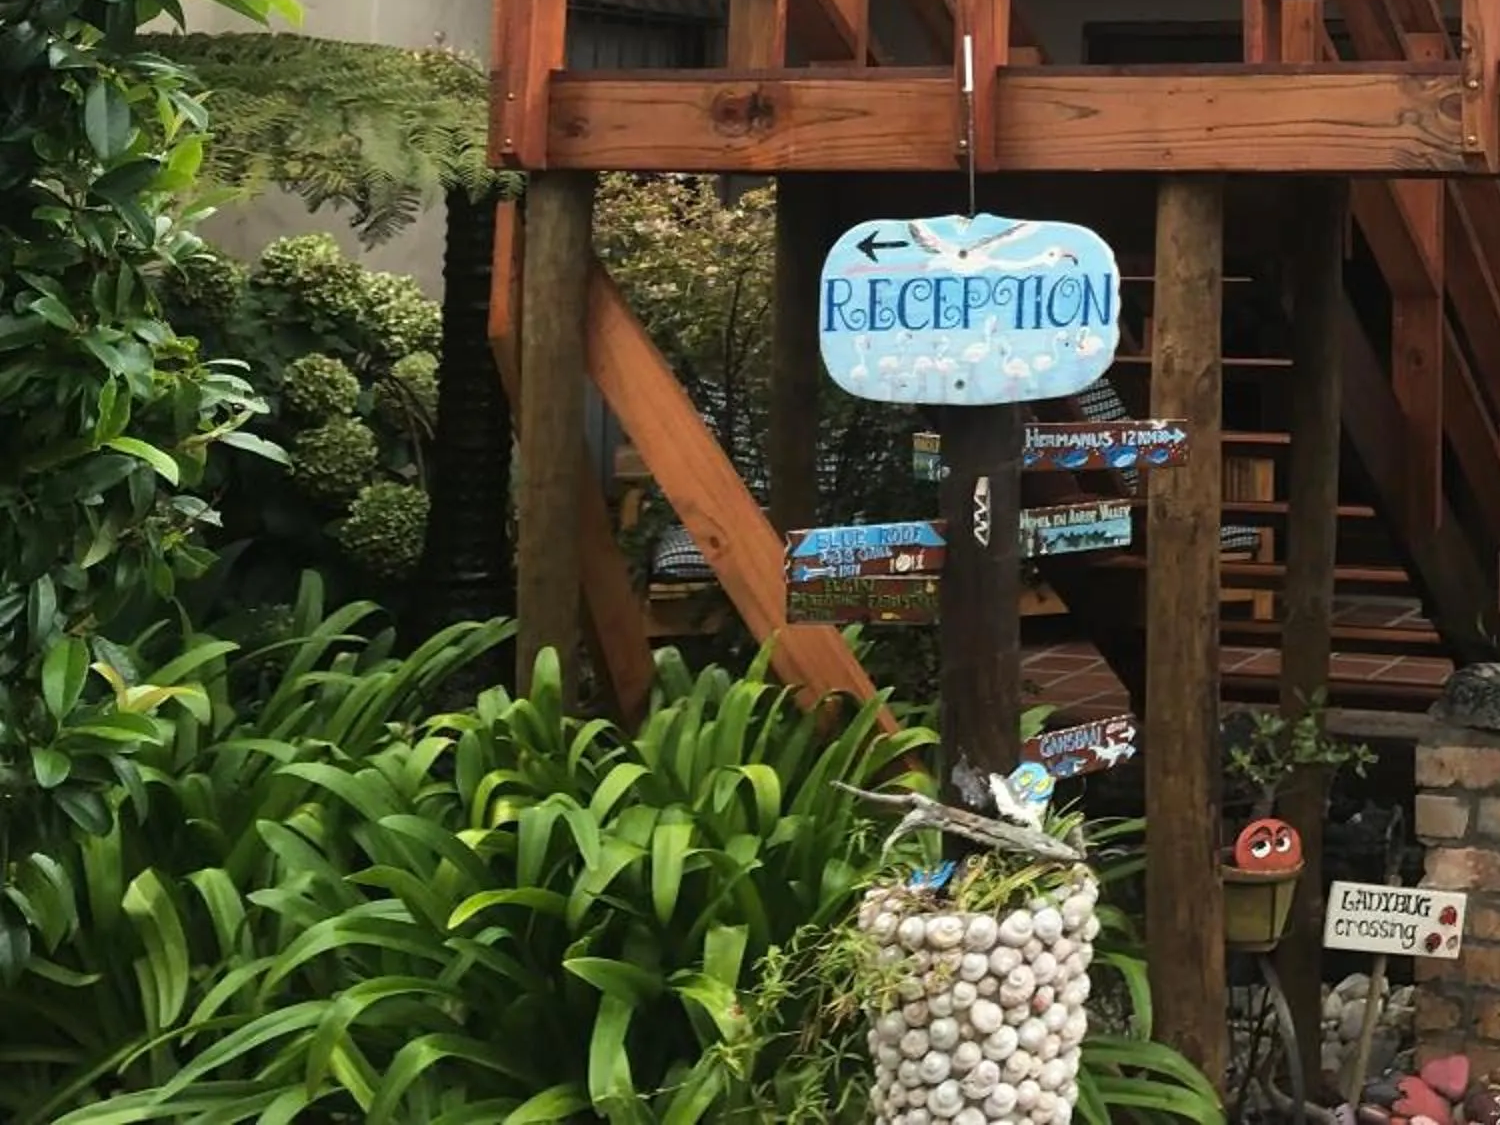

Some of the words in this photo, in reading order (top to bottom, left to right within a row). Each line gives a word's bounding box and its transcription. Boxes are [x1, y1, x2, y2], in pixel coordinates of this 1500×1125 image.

[823, 272, 1112, 332] RECEPTION
[1025, 427, 1113, 448] HERMANUS
[815, 528, 866, 549] BLUE
[1341, 889, 1431, 917] LADYBUG
[1335, 918, 1418, 949] crossing
